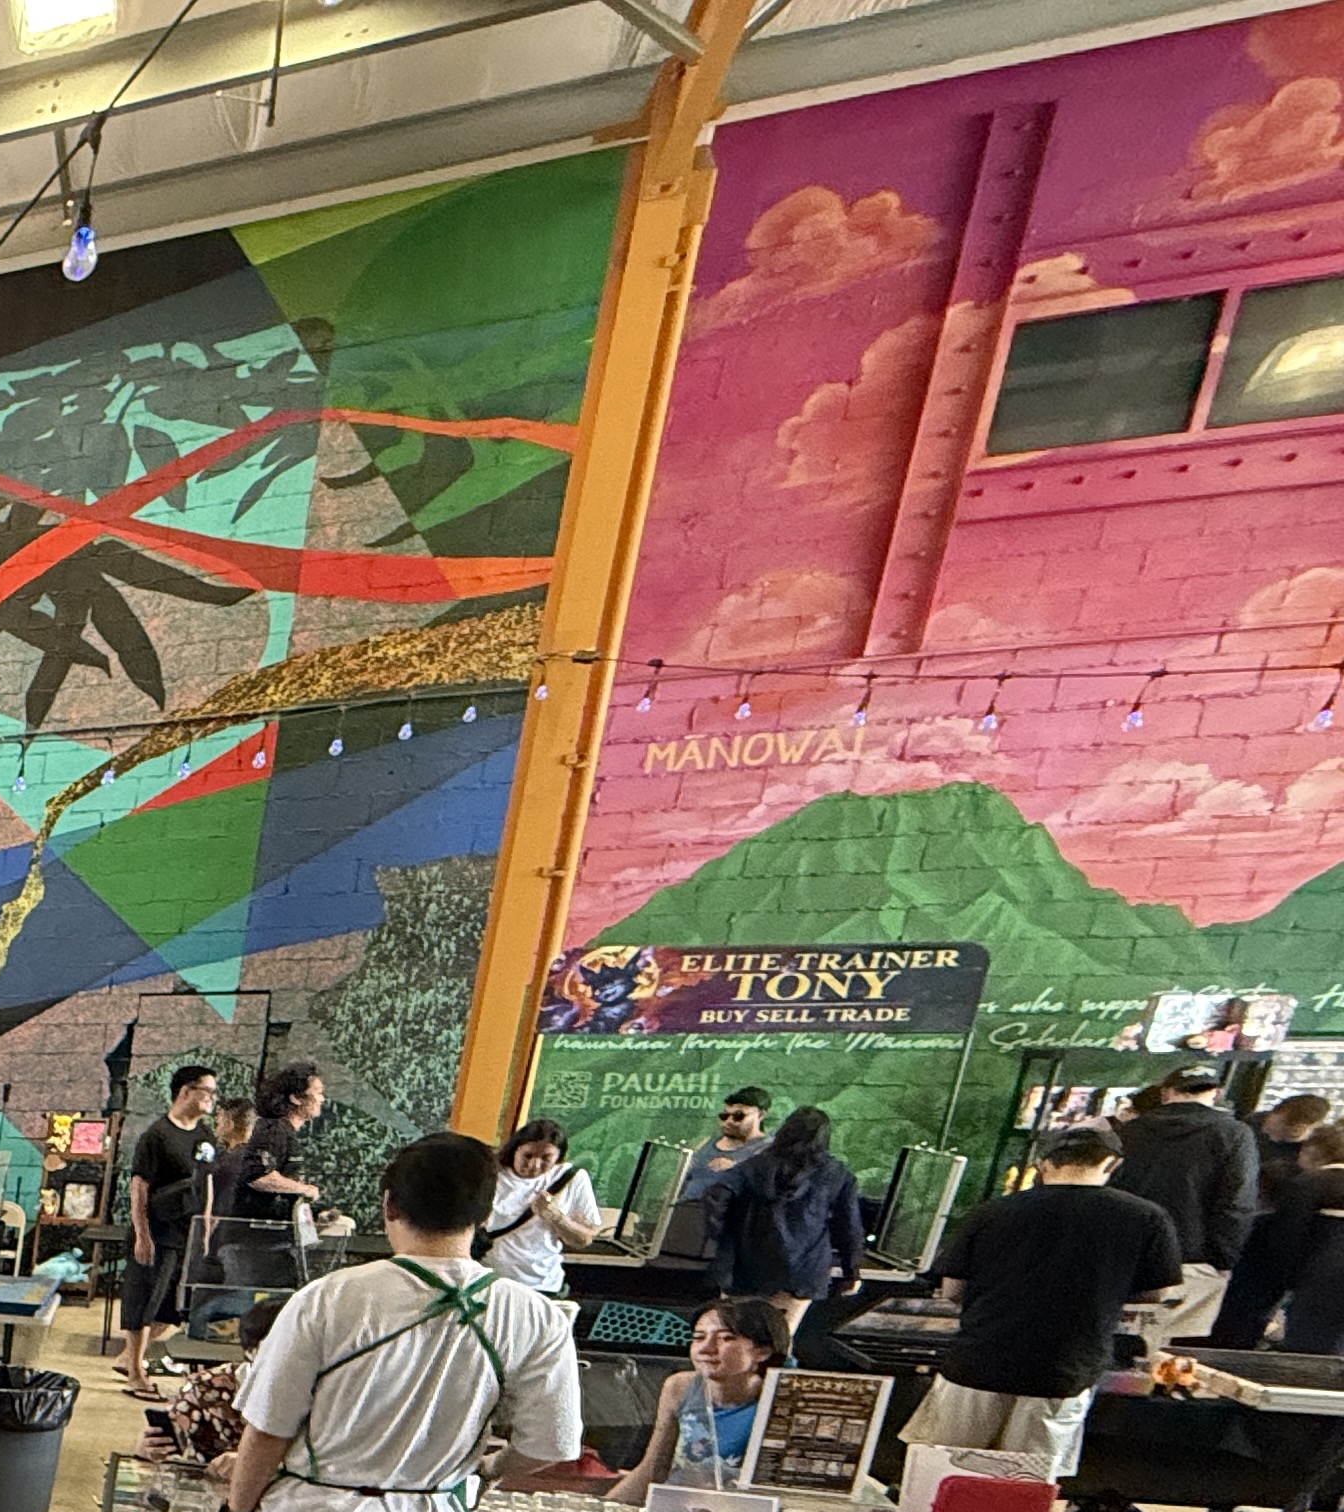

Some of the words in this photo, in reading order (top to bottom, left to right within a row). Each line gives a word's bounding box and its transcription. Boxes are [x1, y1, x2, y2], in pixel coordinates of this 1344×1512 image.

[643, 727, 866, 774] MĀNOWAI
[681, 952, 780, 973] ELITE
[793, 949, 960, 971] TRAINER
[727, 970, 902, 1001] TONY
[699, 1009, 749, 1024] BUY
[755, 1008, 817, 1023] SELL
[823, 1007, 912, 1022] TRADE
[601, 1071, 722, 1094] PAUAHI
[599, 1094, 716, 1110] FOUNDATION
